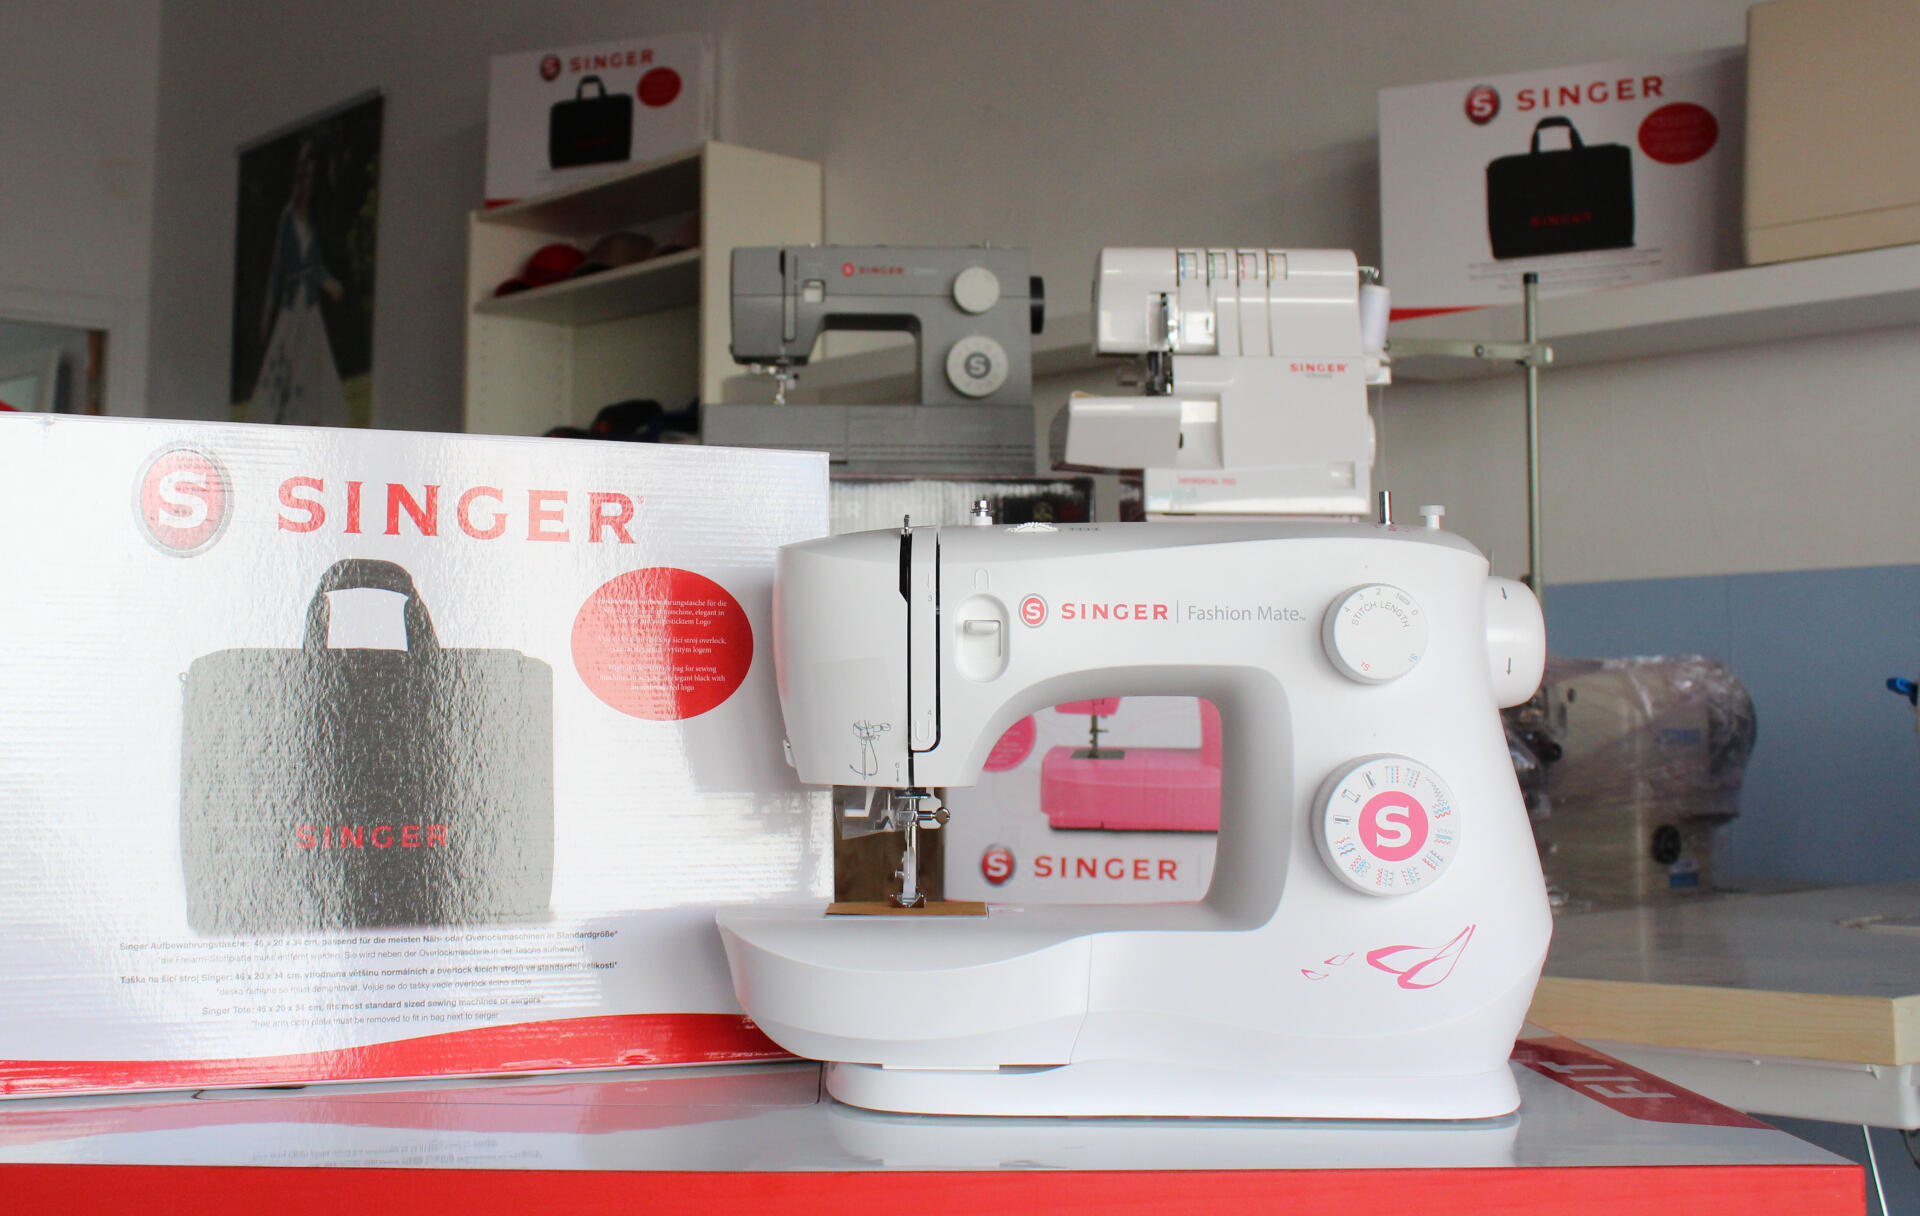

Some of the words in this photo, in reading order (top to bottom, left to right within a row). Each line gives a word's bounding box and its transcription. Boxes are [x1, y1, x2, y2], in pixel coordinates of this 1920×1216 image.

[570, 48, 653, 73] SINGER
[1471, 93, 1493, 116] S
[1516, 75, 1663, 111] SINGER
[969, 356, 986, 375] S
[1290, 362, 1346, 373] SINGER
[157, 470, 208, 529] S
[277, 475, 637, 545] SINGER
[1026, 603, 1041, 620] S
[1061, 602, 1168, 621] SINGER
[1188, 604, 1252, 621] Fashion
[1352, 600, 1377, 626] STITCH
[1380, 600, 1410, 628] LENGTH
[1375, 804, 1412, 848] S
[295, 823, 447, 849] SINGER
[987, 853, 1008, 877] S
[1034, 855, 1178, 880] SINGER
[120, 941, 148, 952] Singer
[359, 936, 372, 944] für
[373, 935, 386, 944] die
[388, 934, 421, 944] meisten
[422, 934, 443, 943] Näh-
[444, 933, 464, 942] oder
[359, 950, 376, 958] wird
[378, 949, 402, 958] neben
[404, 949, 417, 957] der
[381, 966, 428, 976] normálních
[437, 965, 472, 974] overlock
[397, 981, 408, 990] do
[202, 1006, 230, 1016] Singer
[342, 1002, 362, 1010] most
[365, 1000, 402, 1009] standard
[404, 1000, 426, 1008] sized
[427, 998, 456, 1009] sewing
[458, 997, 498, 1006] machines
[366, 1014, 400, 1023] removed
[430, 1013, 444, 1023] bag
[446, 1012, 464, 1021] next
